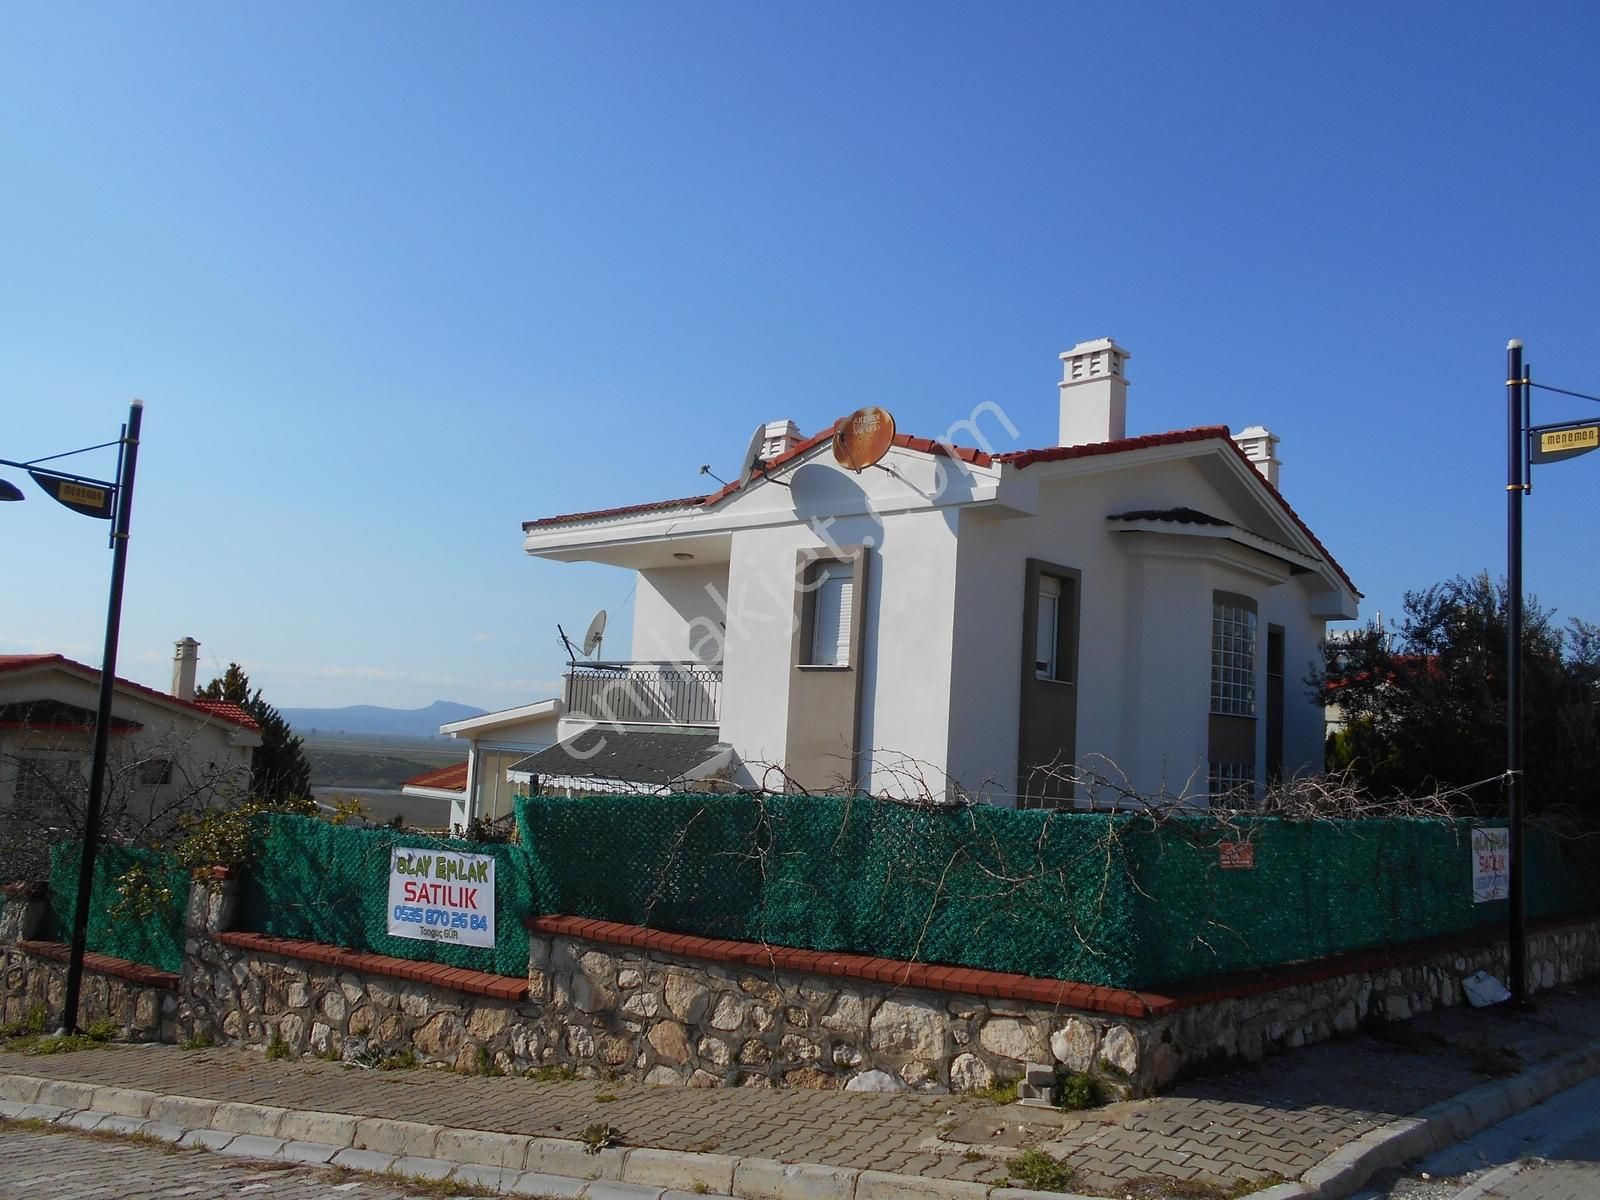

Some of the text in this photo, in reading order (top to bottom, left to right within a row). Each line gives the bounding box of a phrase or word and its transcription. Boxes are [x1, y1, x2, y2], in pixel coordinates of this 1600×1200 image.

[1547, 430, 1594, 445] menemen
[396, 855, 488, 883] OLAY EMLAK
[404, 881, 478, 909] SATILIK
[425, 908, 450, 926] 870
[451, 911, 468, 929] 26
[470, 914, 488, 931] 84
